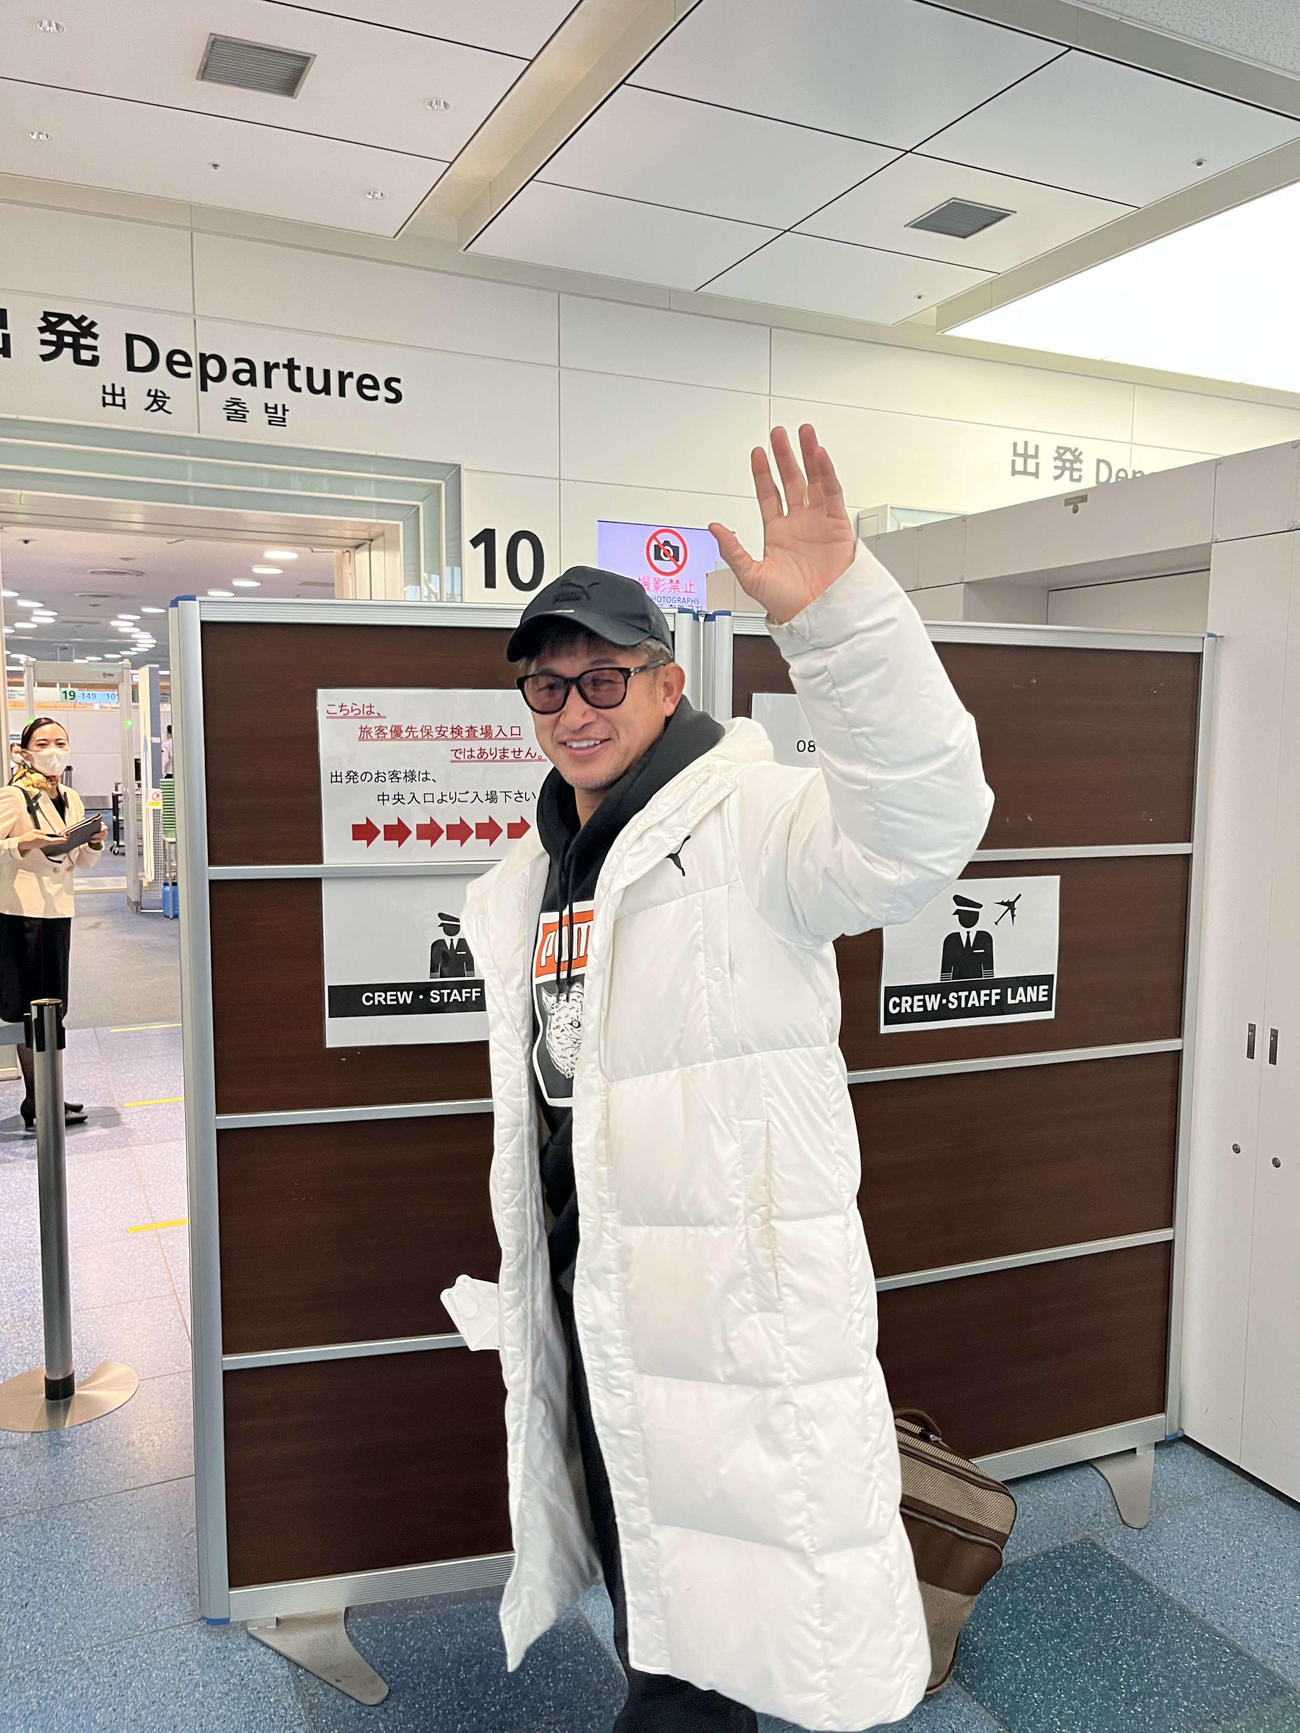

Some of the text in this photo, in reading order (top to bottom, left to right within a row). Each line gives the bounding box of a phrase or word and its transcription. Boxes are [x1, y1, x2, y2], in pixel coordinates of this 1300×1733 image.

[124, 333, 403, 404] Departures
[101, 383, 289, 427] 出发 출발
[1011, 440, 1083, 483] 出発
[469, 528, 544, 592] 10
[62, 690, 76, 700] 19
[326, 702, 383, 717] こちらは、
[358, 724, 522, 740] 旅客優先保安検査場入口
[450, 746, 544, 760] ではありません。
[796, 739, 817, 753] 08
[330, 769, 438, 784] 出発のお客様は、
[377, 790, 537, 806] 中央入口よりご入場下さい
[361, 990, 414, 1006] CREW
[429, 988, 482, 1003] STAFF
[1007, 985, 1049, 1005] LANE
